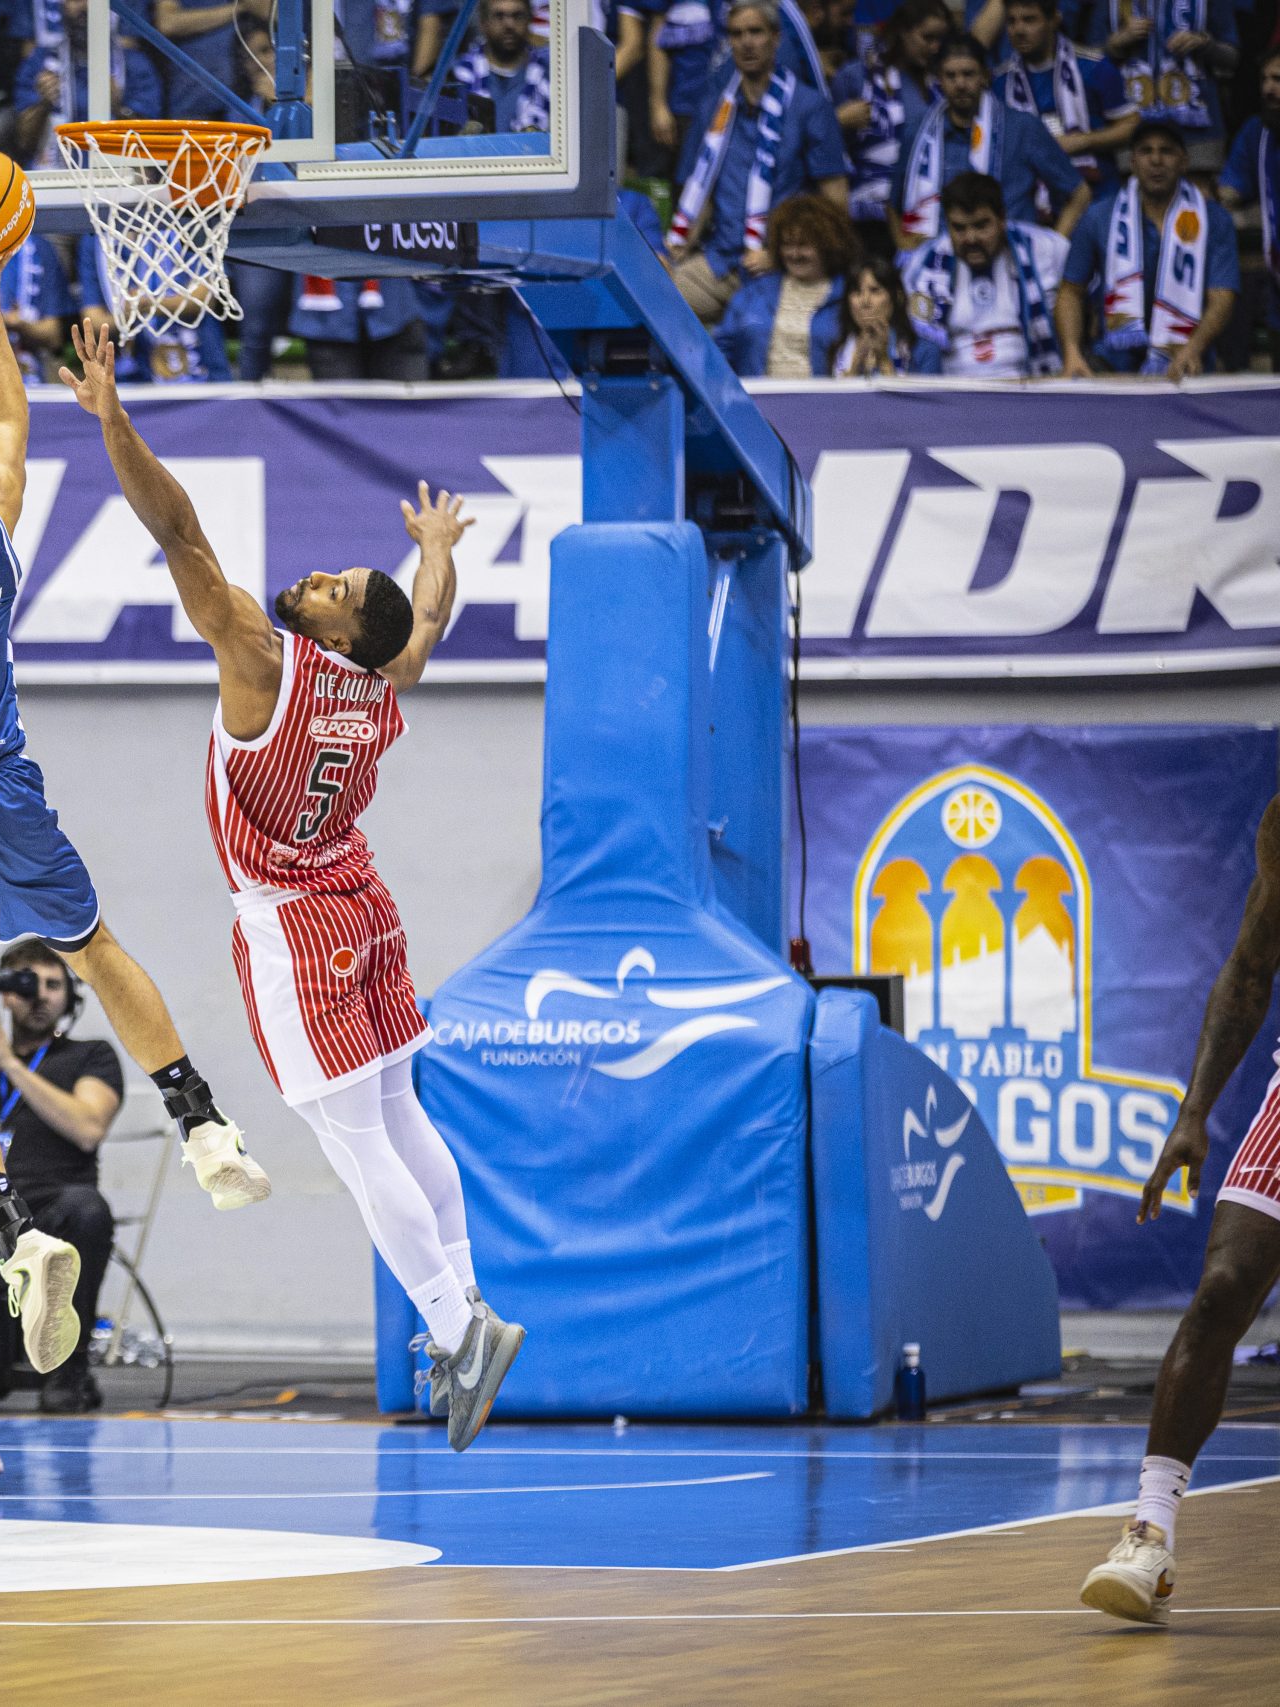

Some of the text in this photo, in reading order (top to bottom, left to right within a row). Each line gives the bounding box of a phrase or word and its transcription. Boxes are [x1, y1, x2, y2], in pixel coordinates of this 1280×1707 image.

[293, 749, 354, 843] 5
[433, 1020, 641, 1051] CAJADEBURGOS
[481, 1046, 581, 1066] FUNDACIÓN
[962, 1043, 1063, 1078] PABLO
[958, 1078, 1172, 1180] GOS
